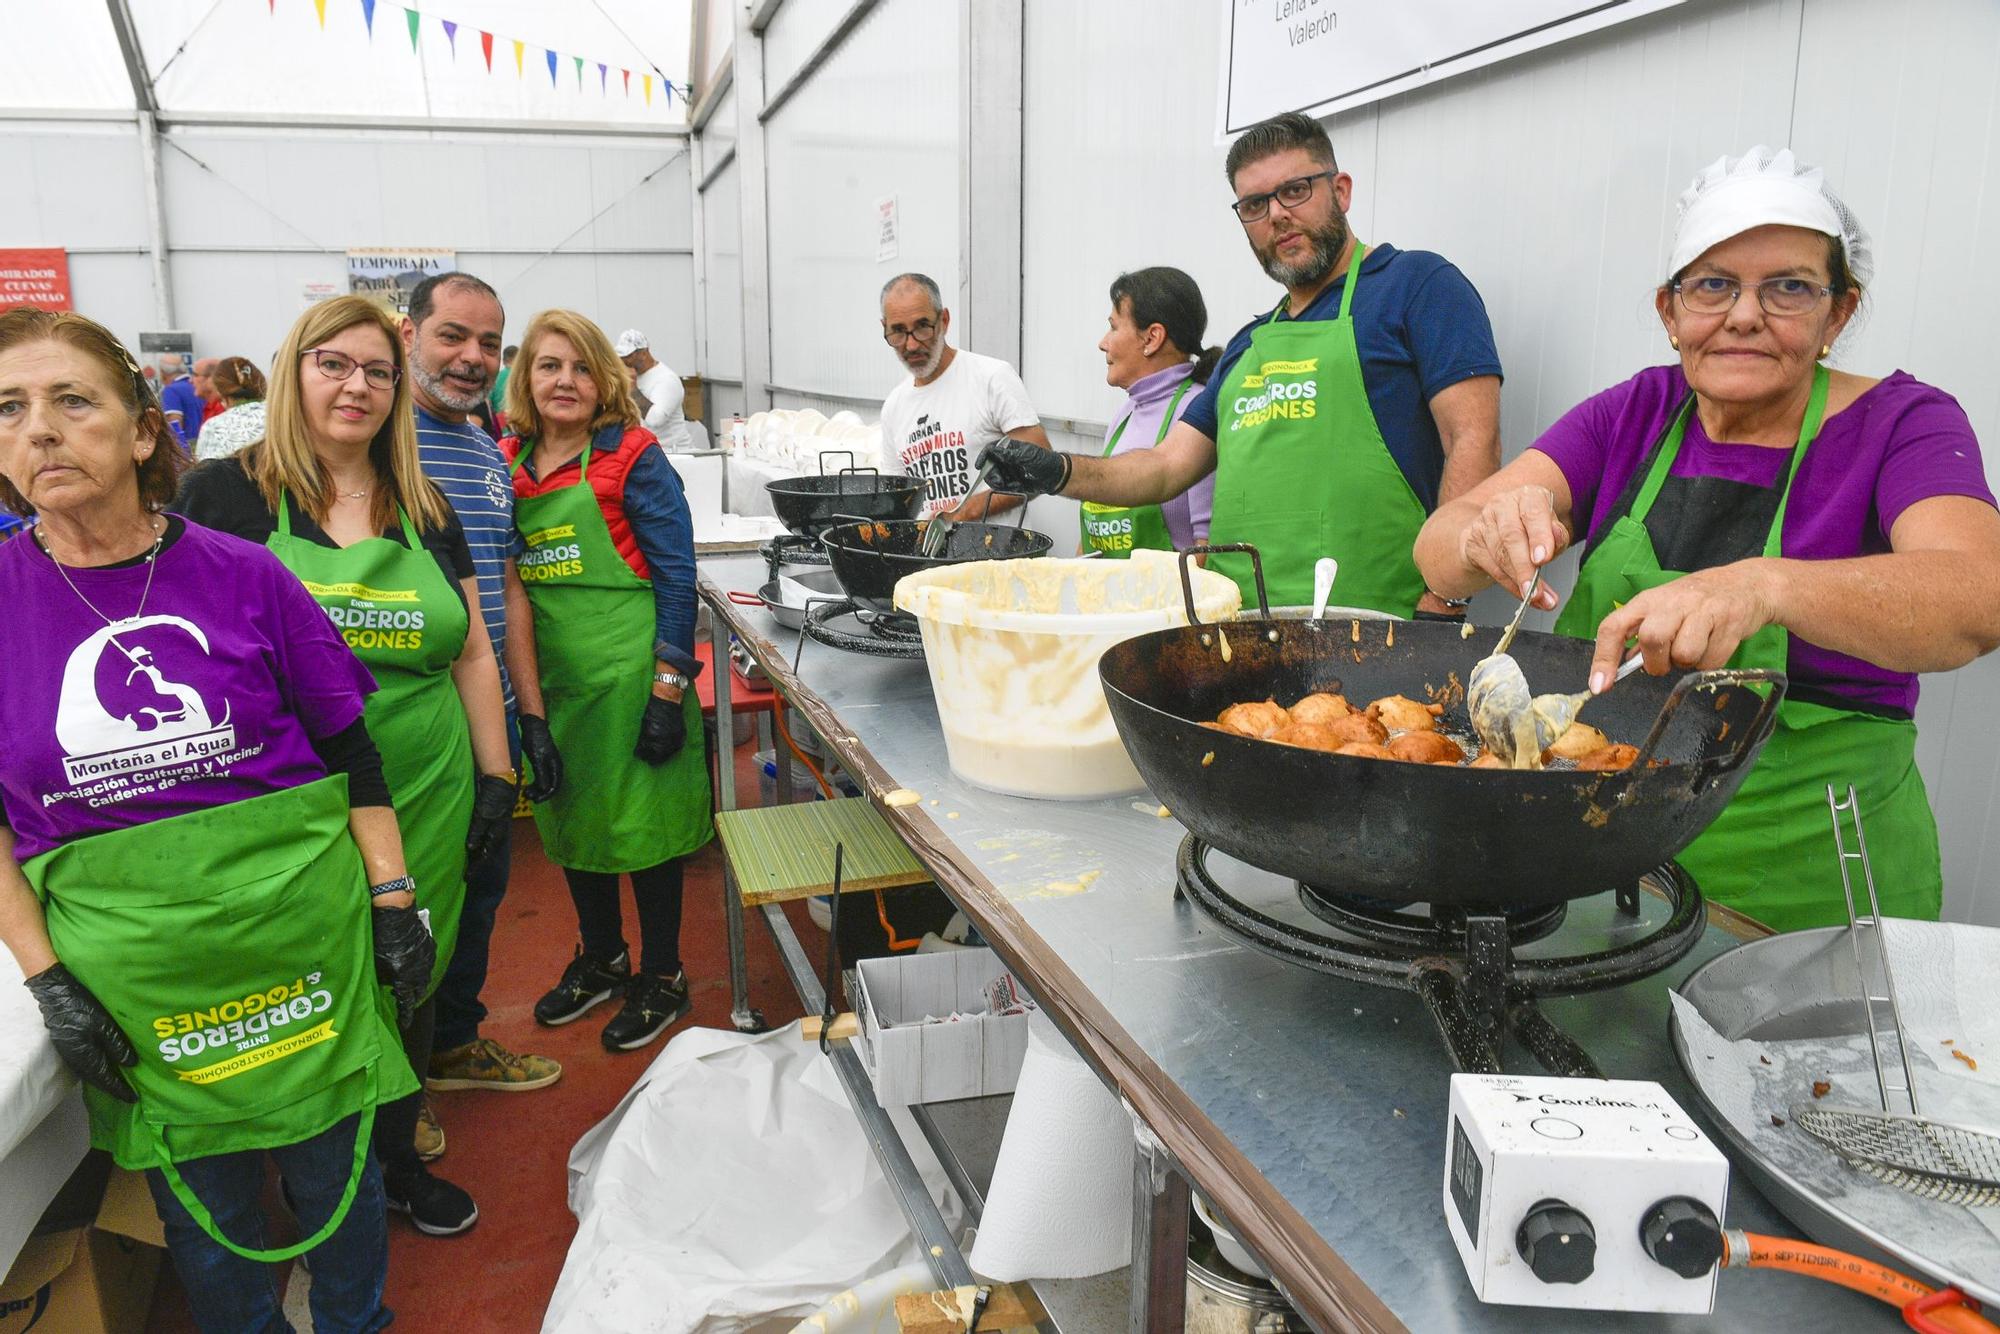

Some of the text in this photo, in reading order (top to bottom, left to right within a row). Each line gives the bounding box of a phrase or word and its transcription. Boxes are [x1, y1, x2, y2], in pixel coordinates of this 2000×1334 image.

[1288, 10, 1337, 47] Valerón
[350, 256, 440, 269] TEMPORADA
[4, 281, 52, 291] CUEVAS
[1231, 420, 1239, 431] &
[321, 606, 425, 630] RDEROS
[342, 628, 423, 650] GONES
[70, 736, 231, 779] Montaña el Agua
[42, 743, 264, 807] Asociación Cultural y Vecinal
[88, 784, 155, 808] Calderos
[158, 778, 177, 791] de
[153, 971, 322, 1038] & FOGONES
[159, 990, 333, 1063] CORDEROS
[237, 1034, 270, 1052] ENTRE
[277, 1030, 324, 1053] JORNADA
[1538, 1093, 1639, 1109] Garcima
